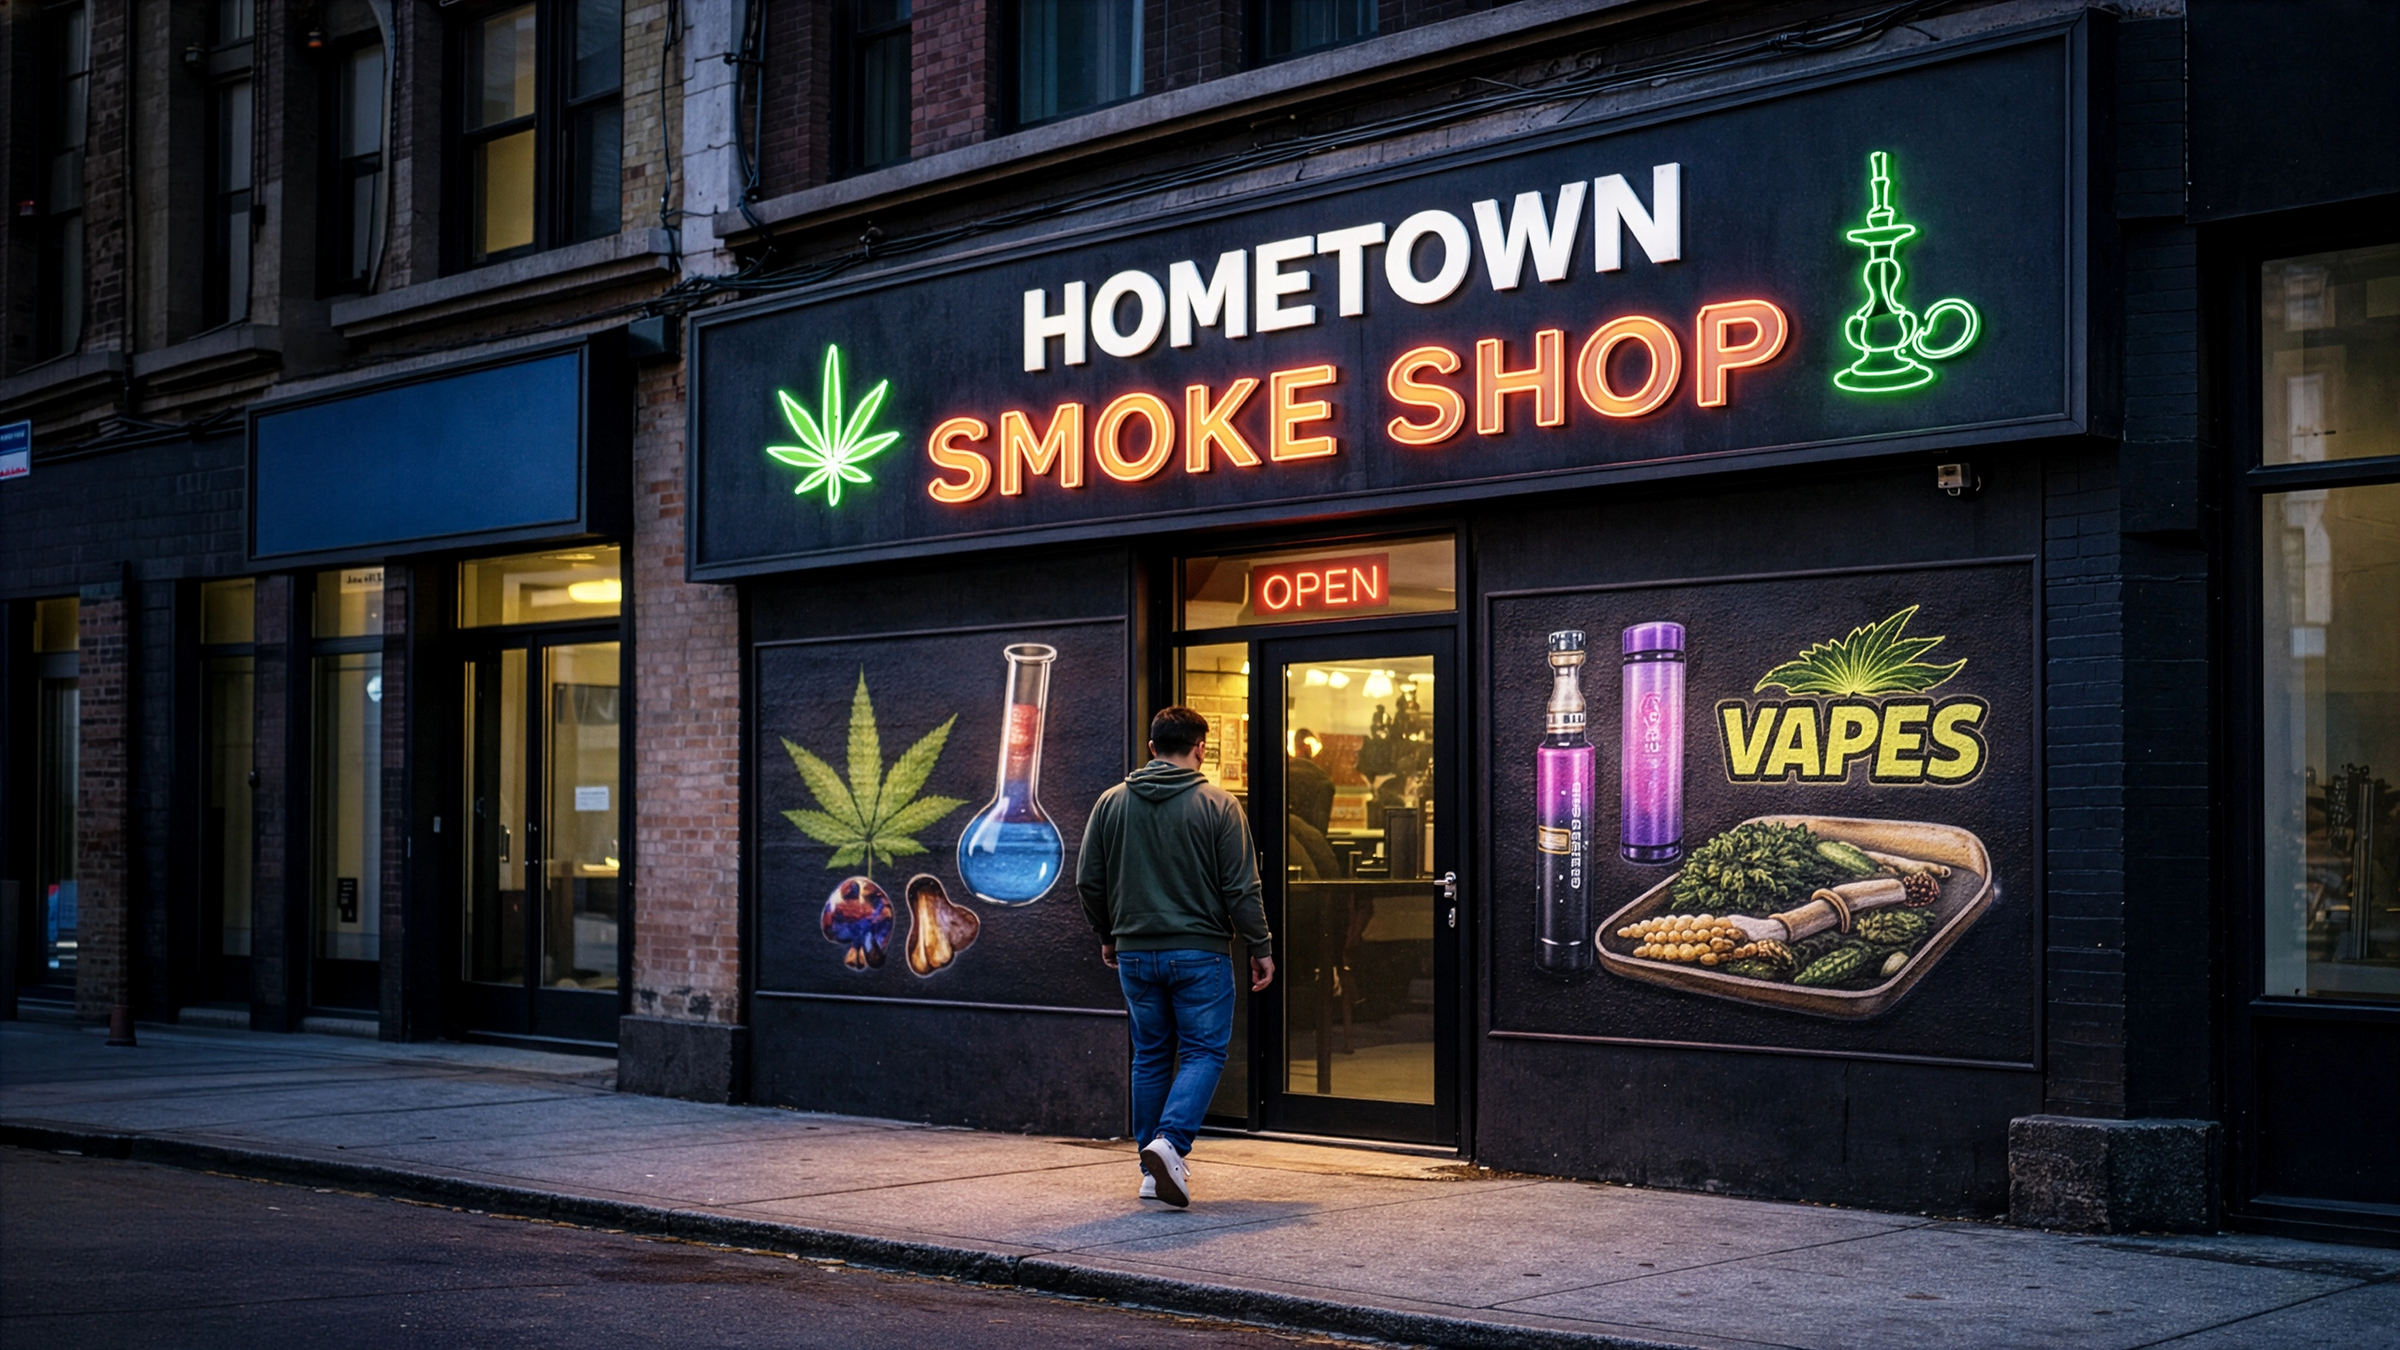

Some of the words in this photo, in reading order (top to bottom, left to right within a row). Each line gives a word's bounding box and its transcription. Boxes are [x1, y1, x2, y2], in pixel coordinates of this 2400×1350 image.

[1023, 162, 1681, 371] HOMETOWN
[926, 363, 1338, 505] SMOKE
[1386, 298, 1789, 446] SHOP
[1263, 565, 1378, 610] OPEN
[1721, 702, 1984, 780] VAPES
